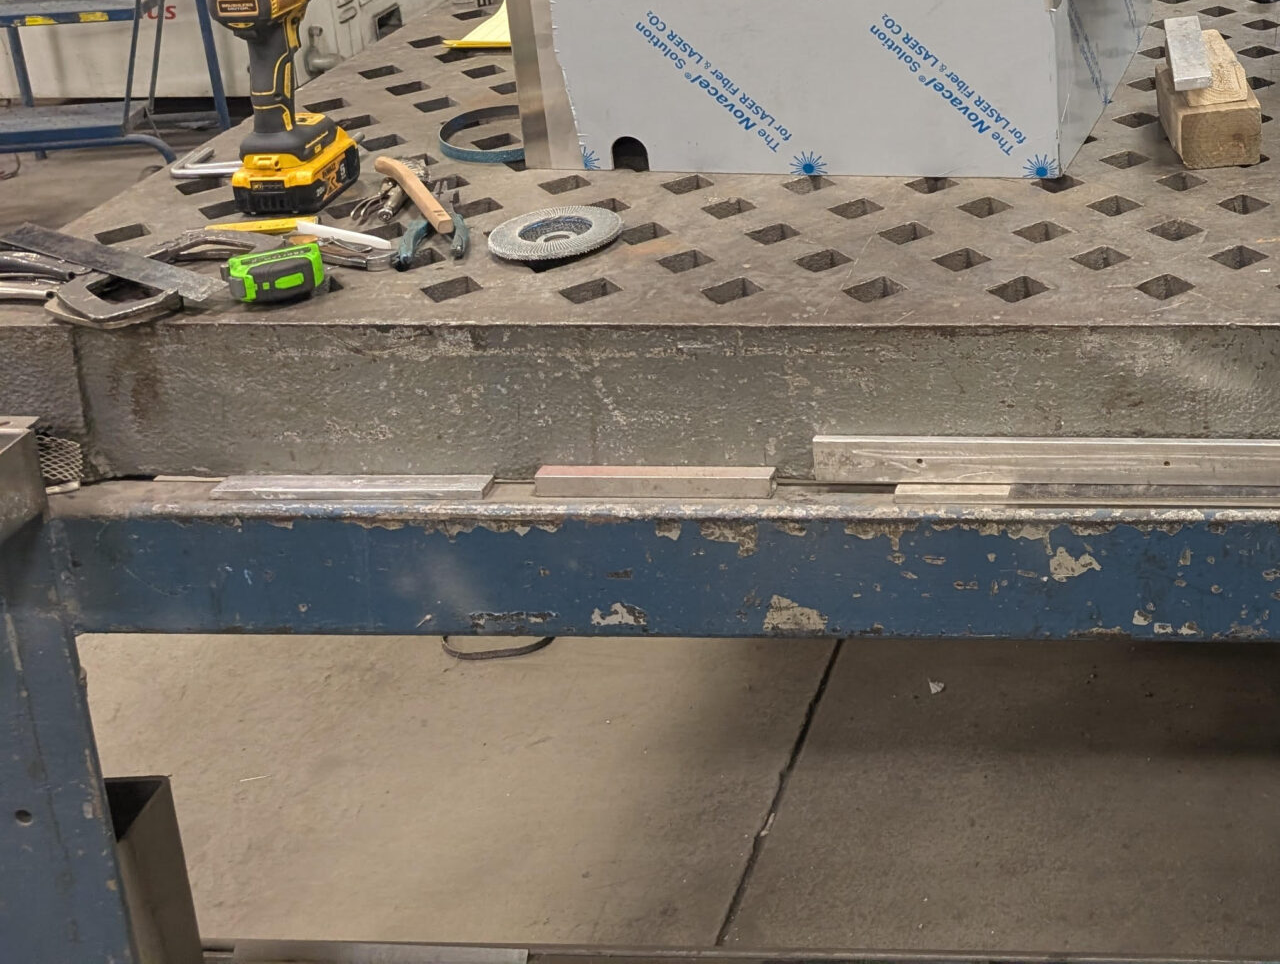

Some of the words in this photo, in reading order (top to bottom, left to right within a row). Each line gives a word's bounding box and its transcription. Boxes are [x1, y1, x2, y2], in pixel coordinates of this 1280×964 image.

[635, 21, 686, 70] Solution
[667, 30, 704, 65] LASER
[869, 24, 921, 73] Solution
[902, 32, 939, 67] LASER
[704, 61, 712, 70] &
[939, 63, 947, 72] &
[710, 68, 740, 96] Fiber
[945, 72, 975, 99] Fiber
[739, 92, 776, 127] LASER
[973, 95, 1011, 130] LASER
[757, 128, 780, 153] The
[774, 125, 793, 142] for
[991, 131, 1014, 156] The
[1008, 127, 1027, 145] for
